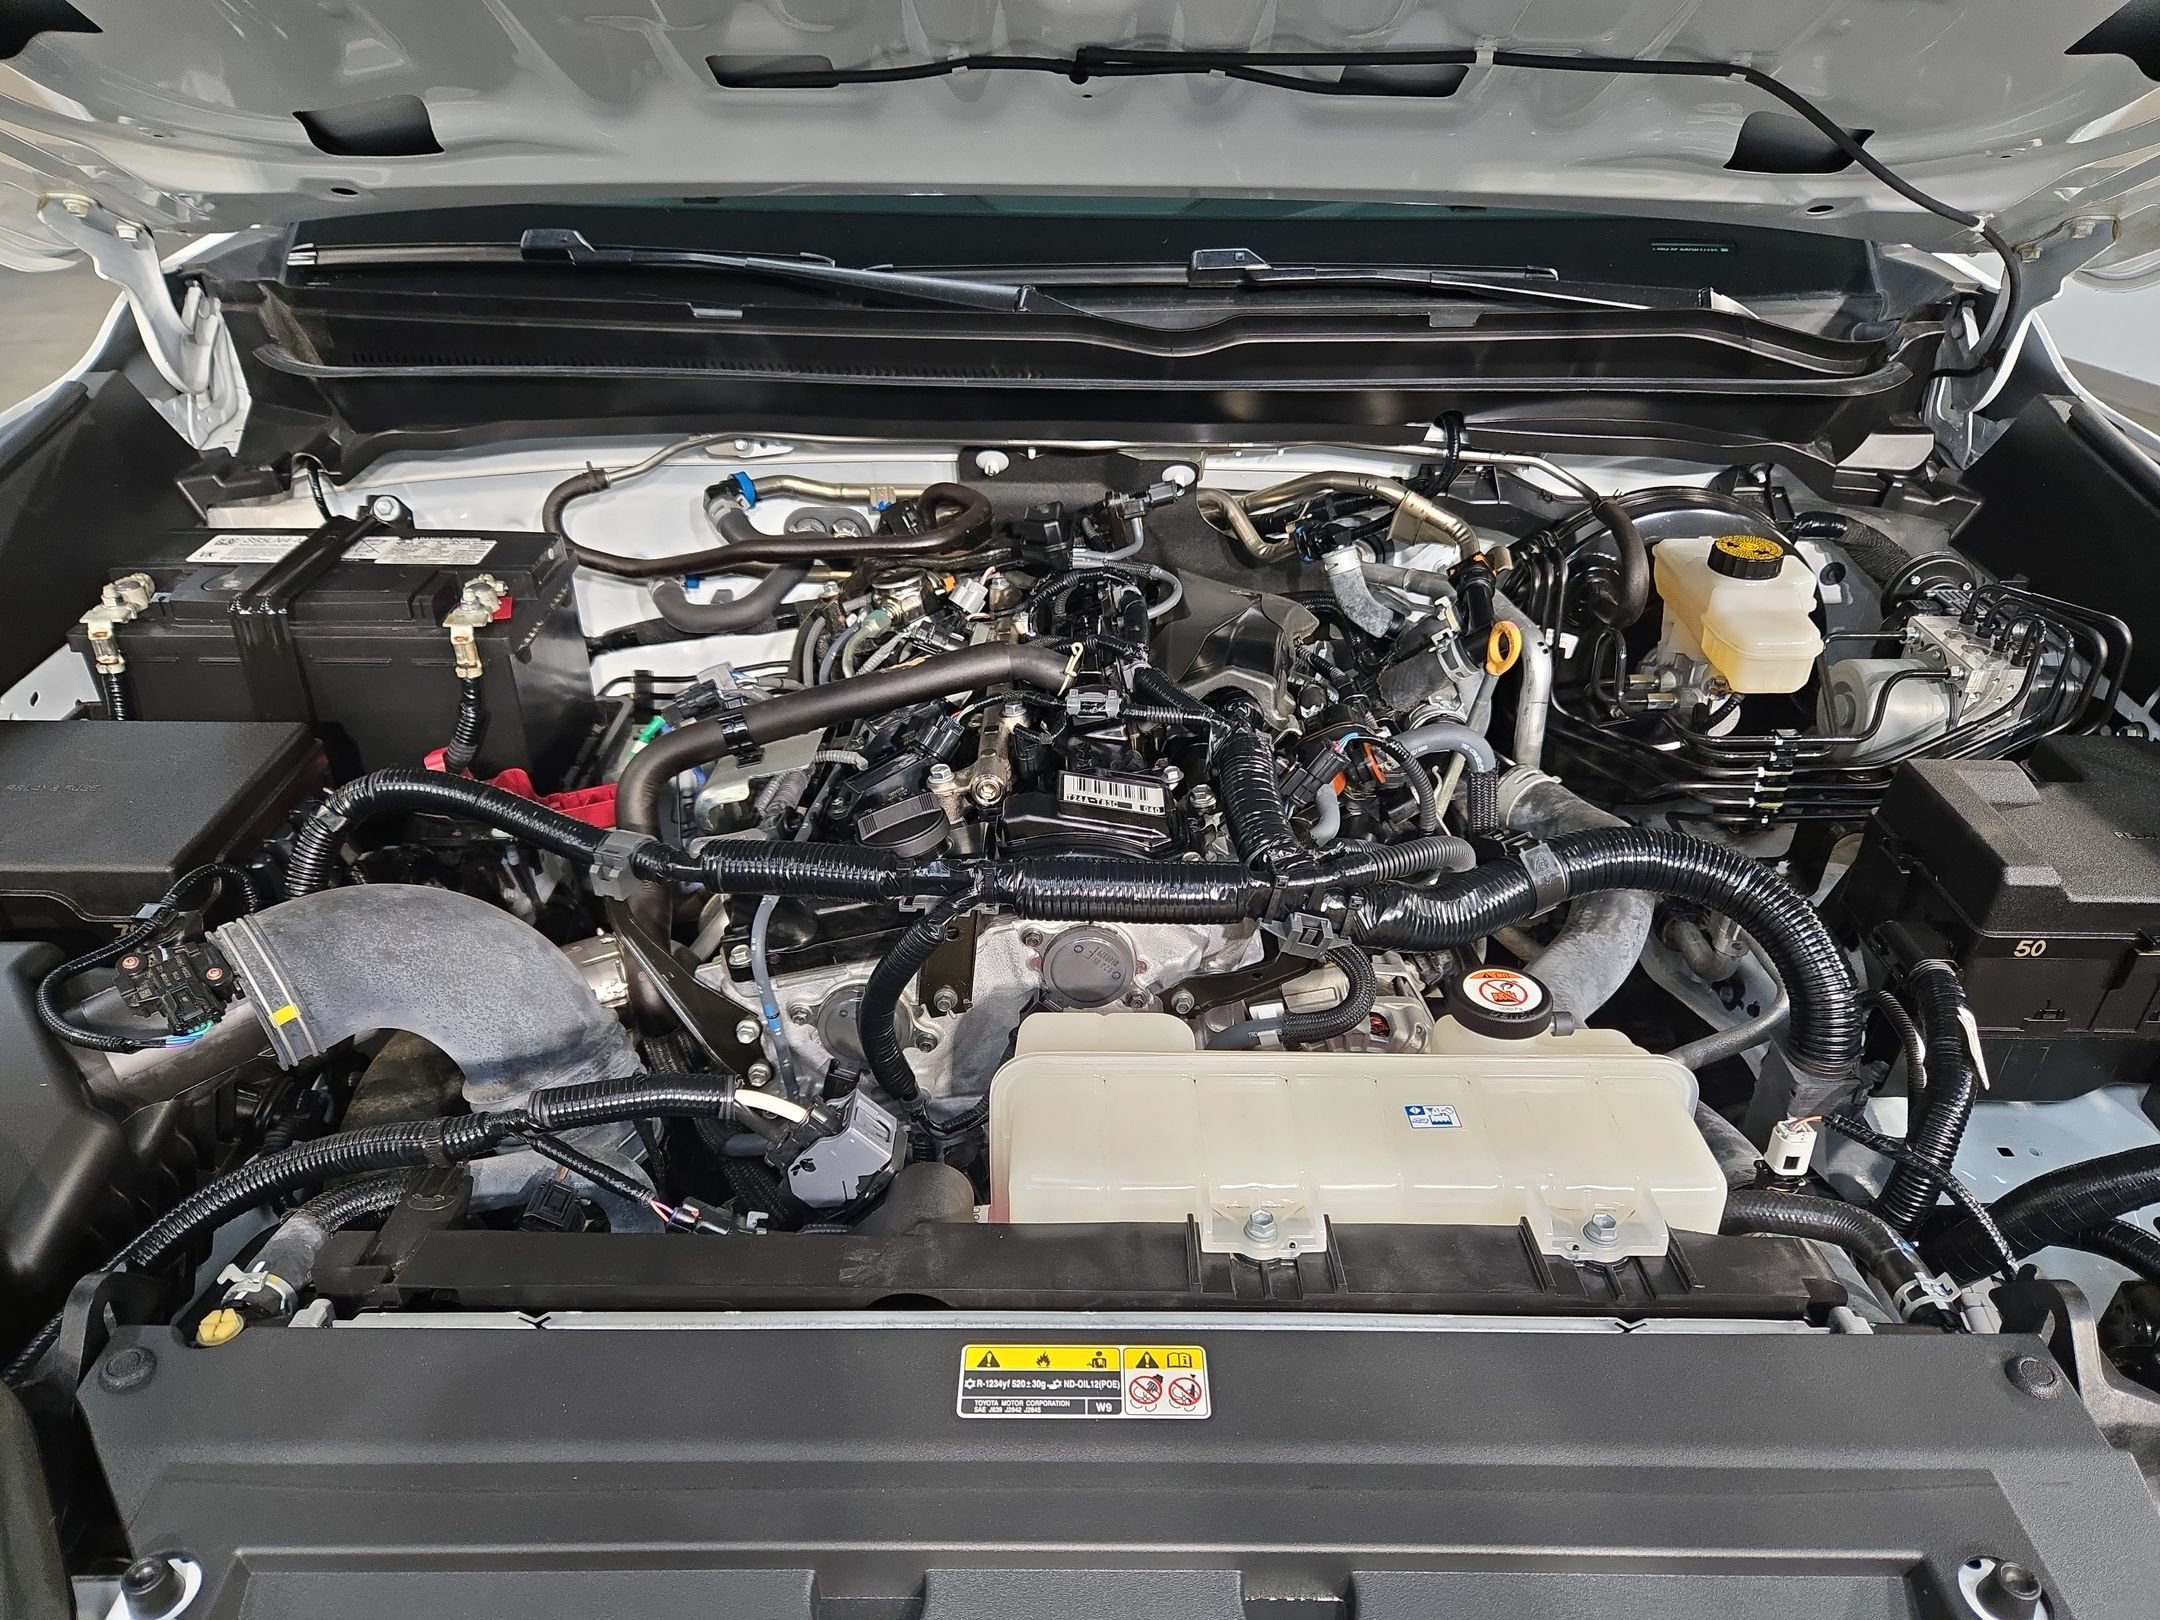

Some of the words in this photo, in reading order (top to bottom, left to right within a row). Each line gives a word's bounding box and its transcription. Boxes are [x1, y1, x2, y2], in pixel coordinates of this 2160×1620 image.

[2013, 939, 2047, 957] 50
[976, 1379, 1010, 1390] R-1234yf
[1011, 1379, 1046, 1390] 520±30g
[1063, 1379, 1121, 1391] ND-OIL12(POE)
[974, 1399, 999, 1407] TOYOTA
[1001, 1399, 1024, 1407] MOTOR
[1025, 1399, 1071, 1408] CORPORATION
[1095, 1402, 1113, 1412] W9
